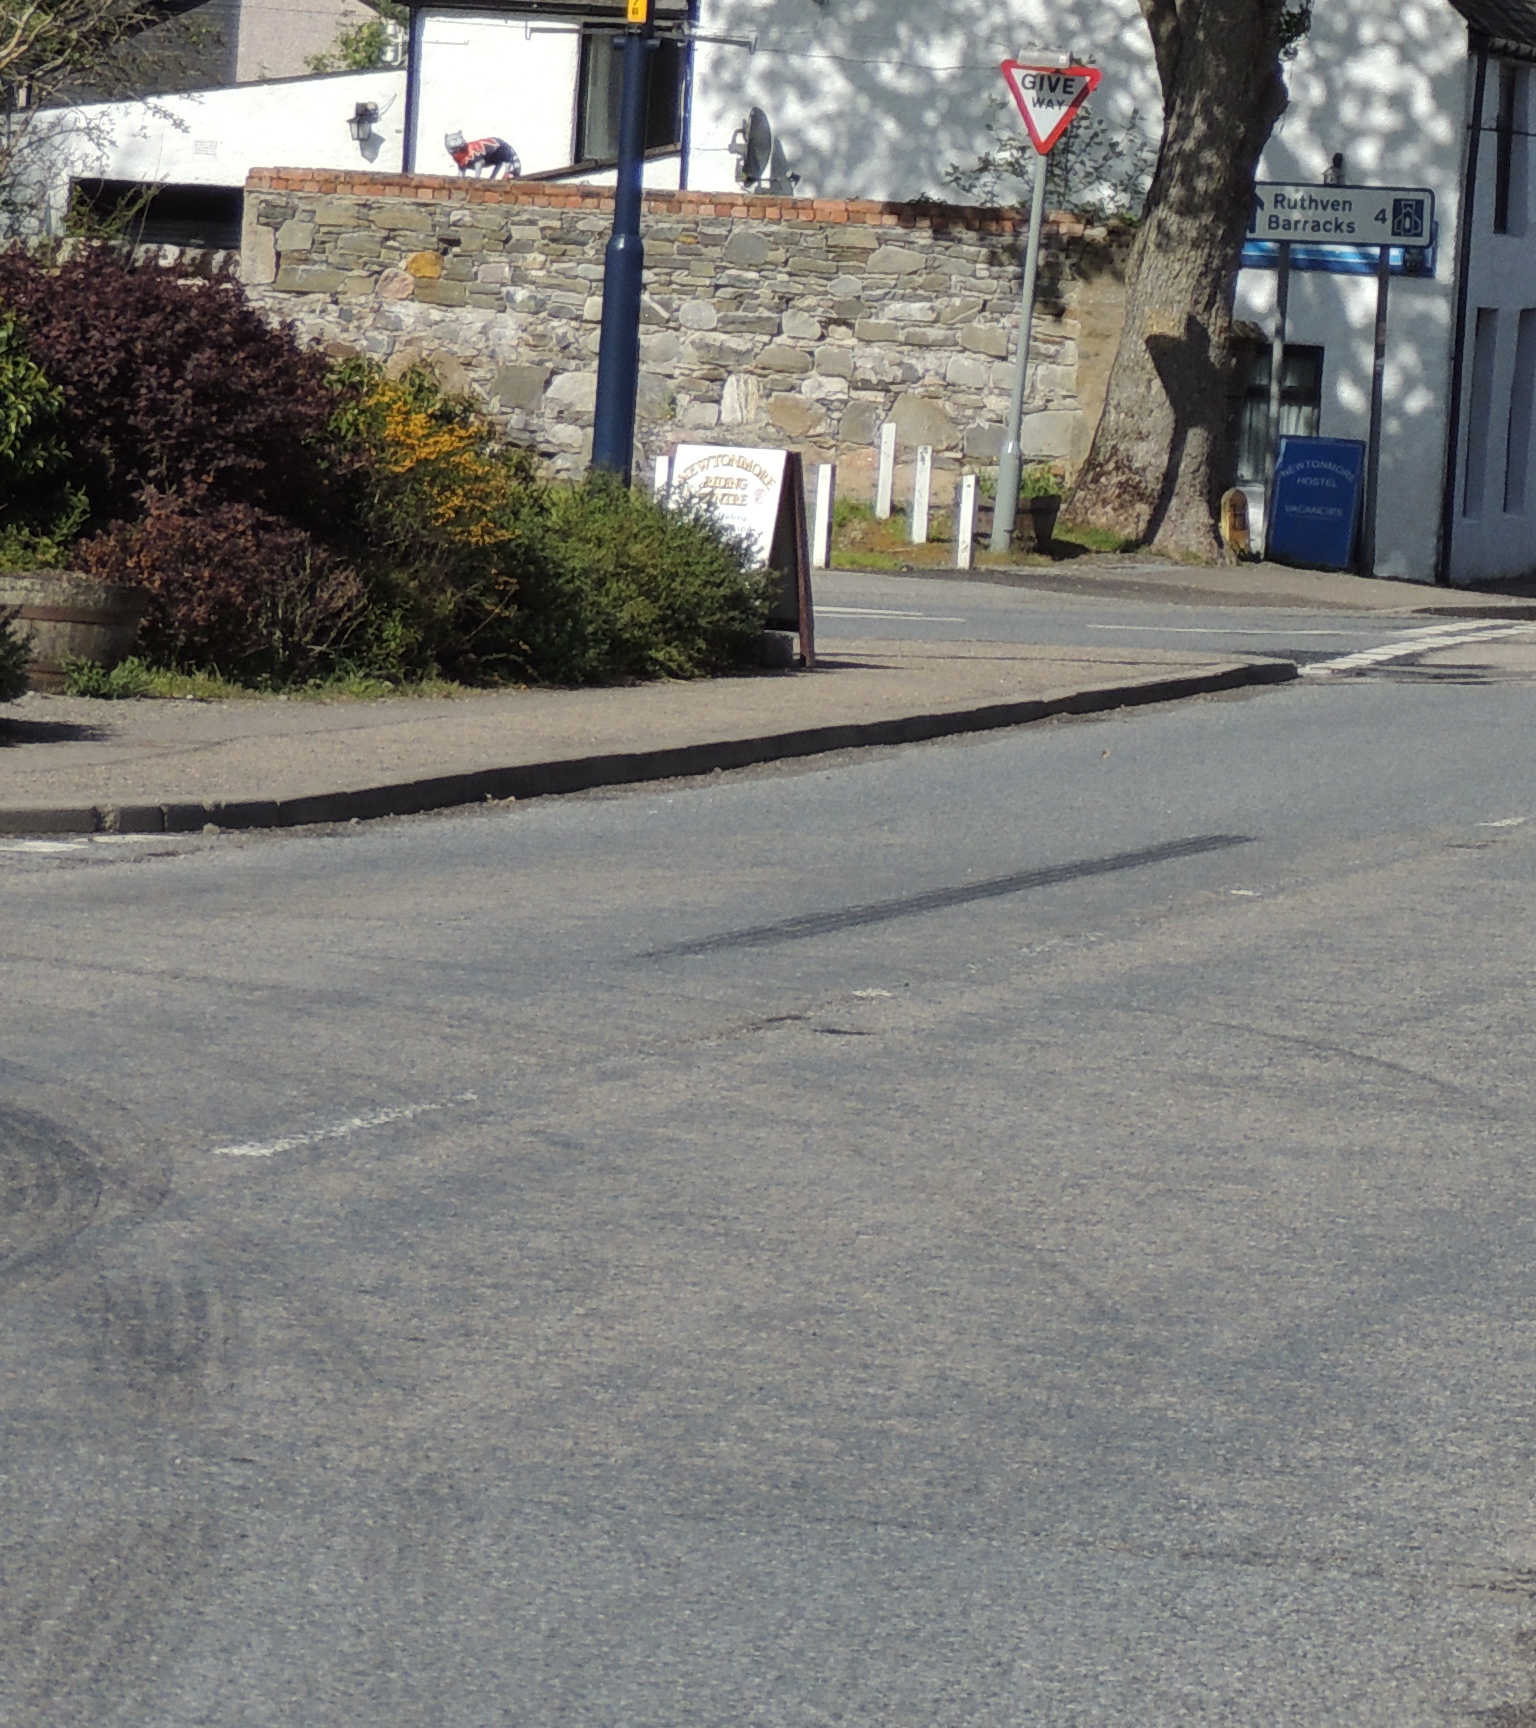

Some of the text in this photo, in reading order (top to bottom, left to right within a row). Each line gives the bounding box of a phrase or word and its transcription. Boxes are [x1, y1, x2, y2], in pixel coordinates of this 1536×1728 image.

[1021, 74, 1075, 95] GIVE
[1032, 97, 1066, 112] WAY
[1273, 192, 1353, 213] Ruthven
[1267, 208, 1388, 234] Barracks 4
[678, 454, 777, 492] NEWTONMORE
[1279, 459, 1356, 483] NEWTONMORE
[1296, 476, 1337, 488] HOSTEL
